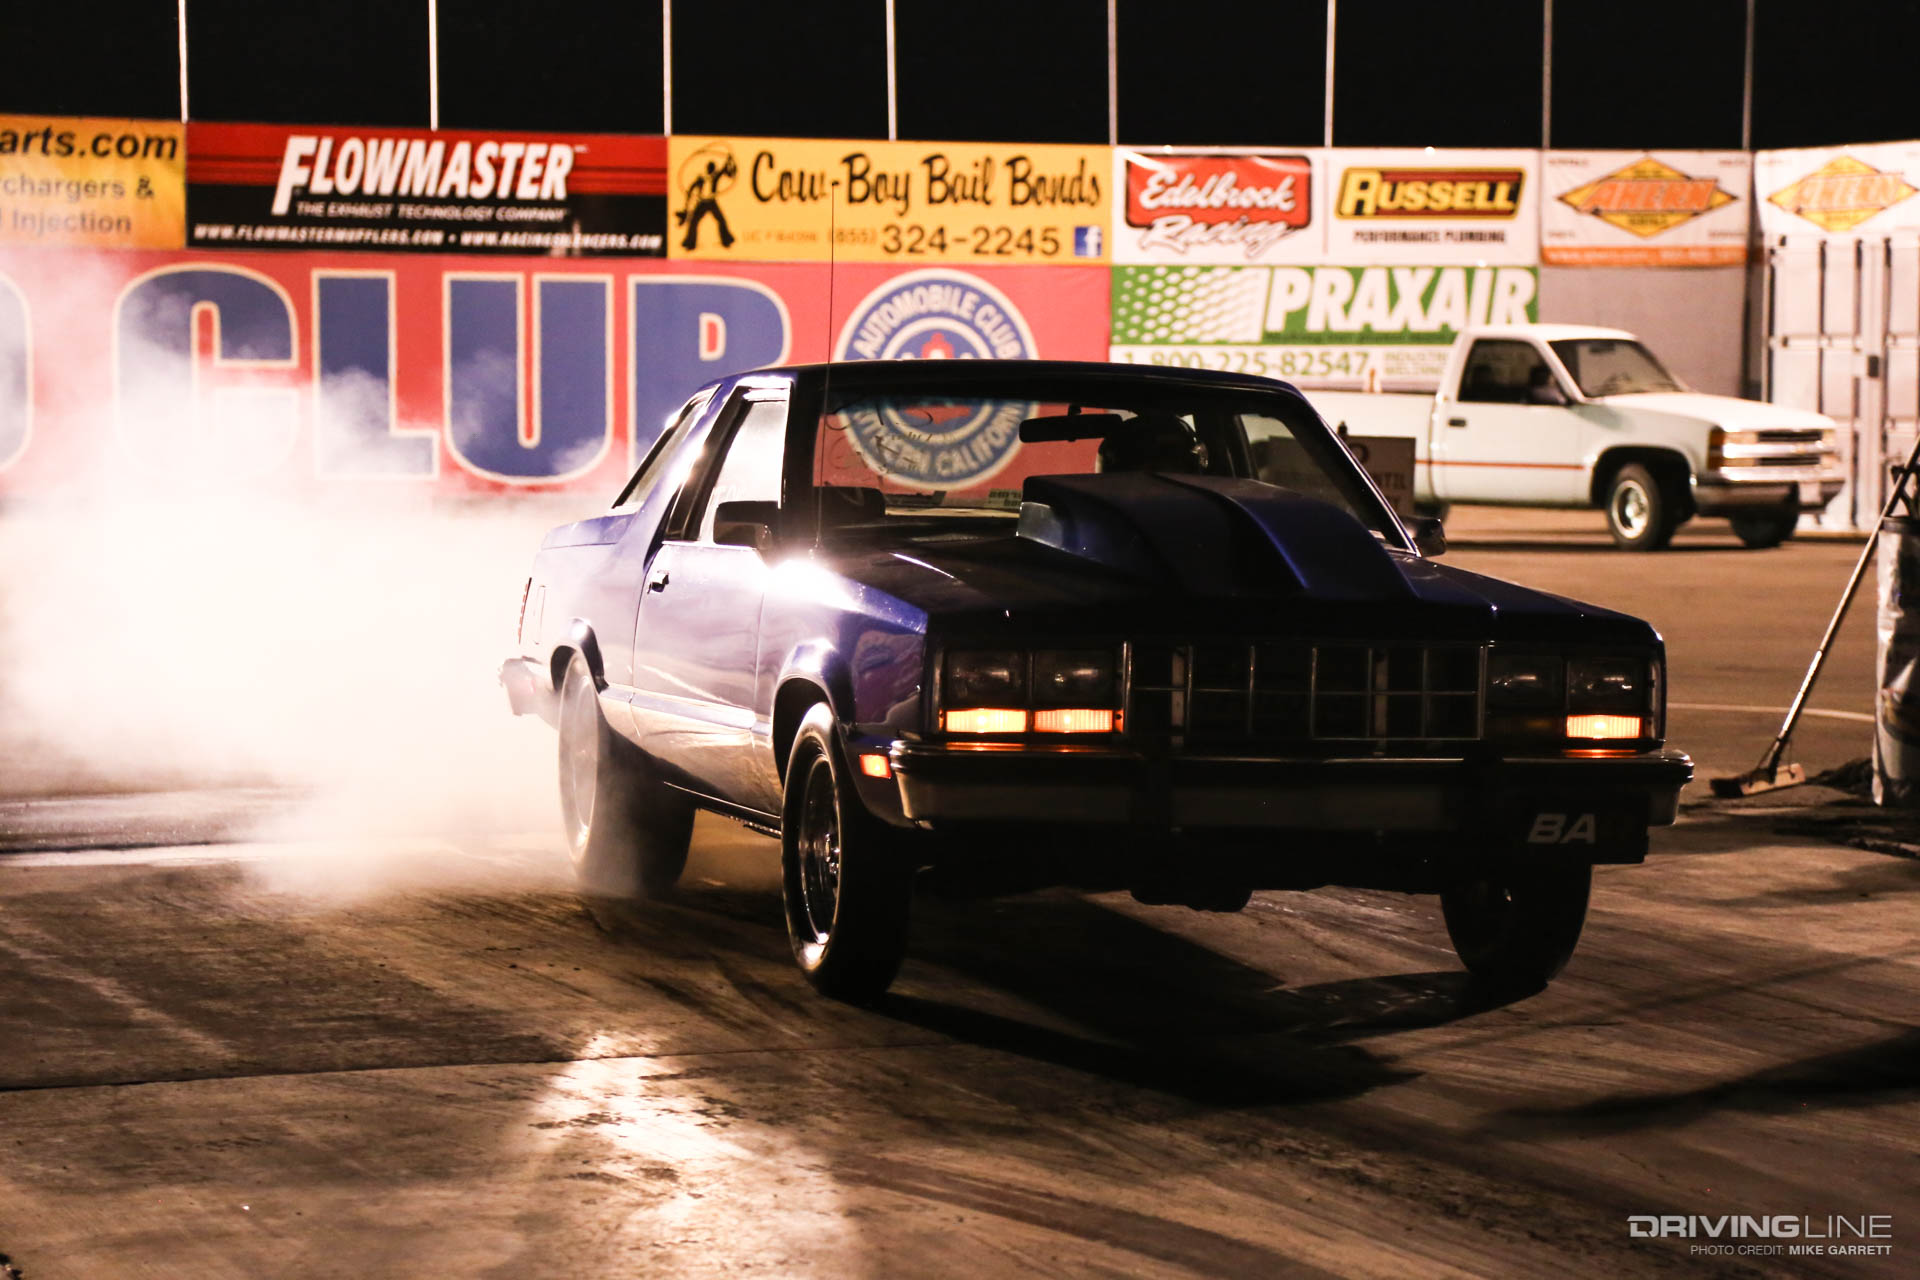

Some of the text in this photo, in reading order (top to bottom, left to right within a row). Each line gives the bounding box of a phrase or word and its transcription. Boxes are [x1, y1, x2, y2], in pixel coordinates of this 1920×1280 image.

[0, 127, 178, 160] arts.com
[0, 174, 154, 200] chargers &
[271, 134, 575, 216] FLOWMASTER
[752, 151, 1100, 216] Cow-Boy Bail Bonds
[1139, 169, 1296, 212] Edelbrock
[1342, 168, 1516, 217] RUSSELL
[11, 209, 132, 238] Injection
[296, 201, 565, 222] THE EXHAUST TECHNOLOGY COMPANY
[882, 224, 1061, 257] 324-2245
[1138, 214, 1300, 259] Racing
[1265, 266, 1539, 333] PRAXAIR
[852, 284, 1022, 360] AUTOMOBILE CLUB
[935, 402, 1025, 477] CALIFORN
[1527, 813, 1597, 845] BA
